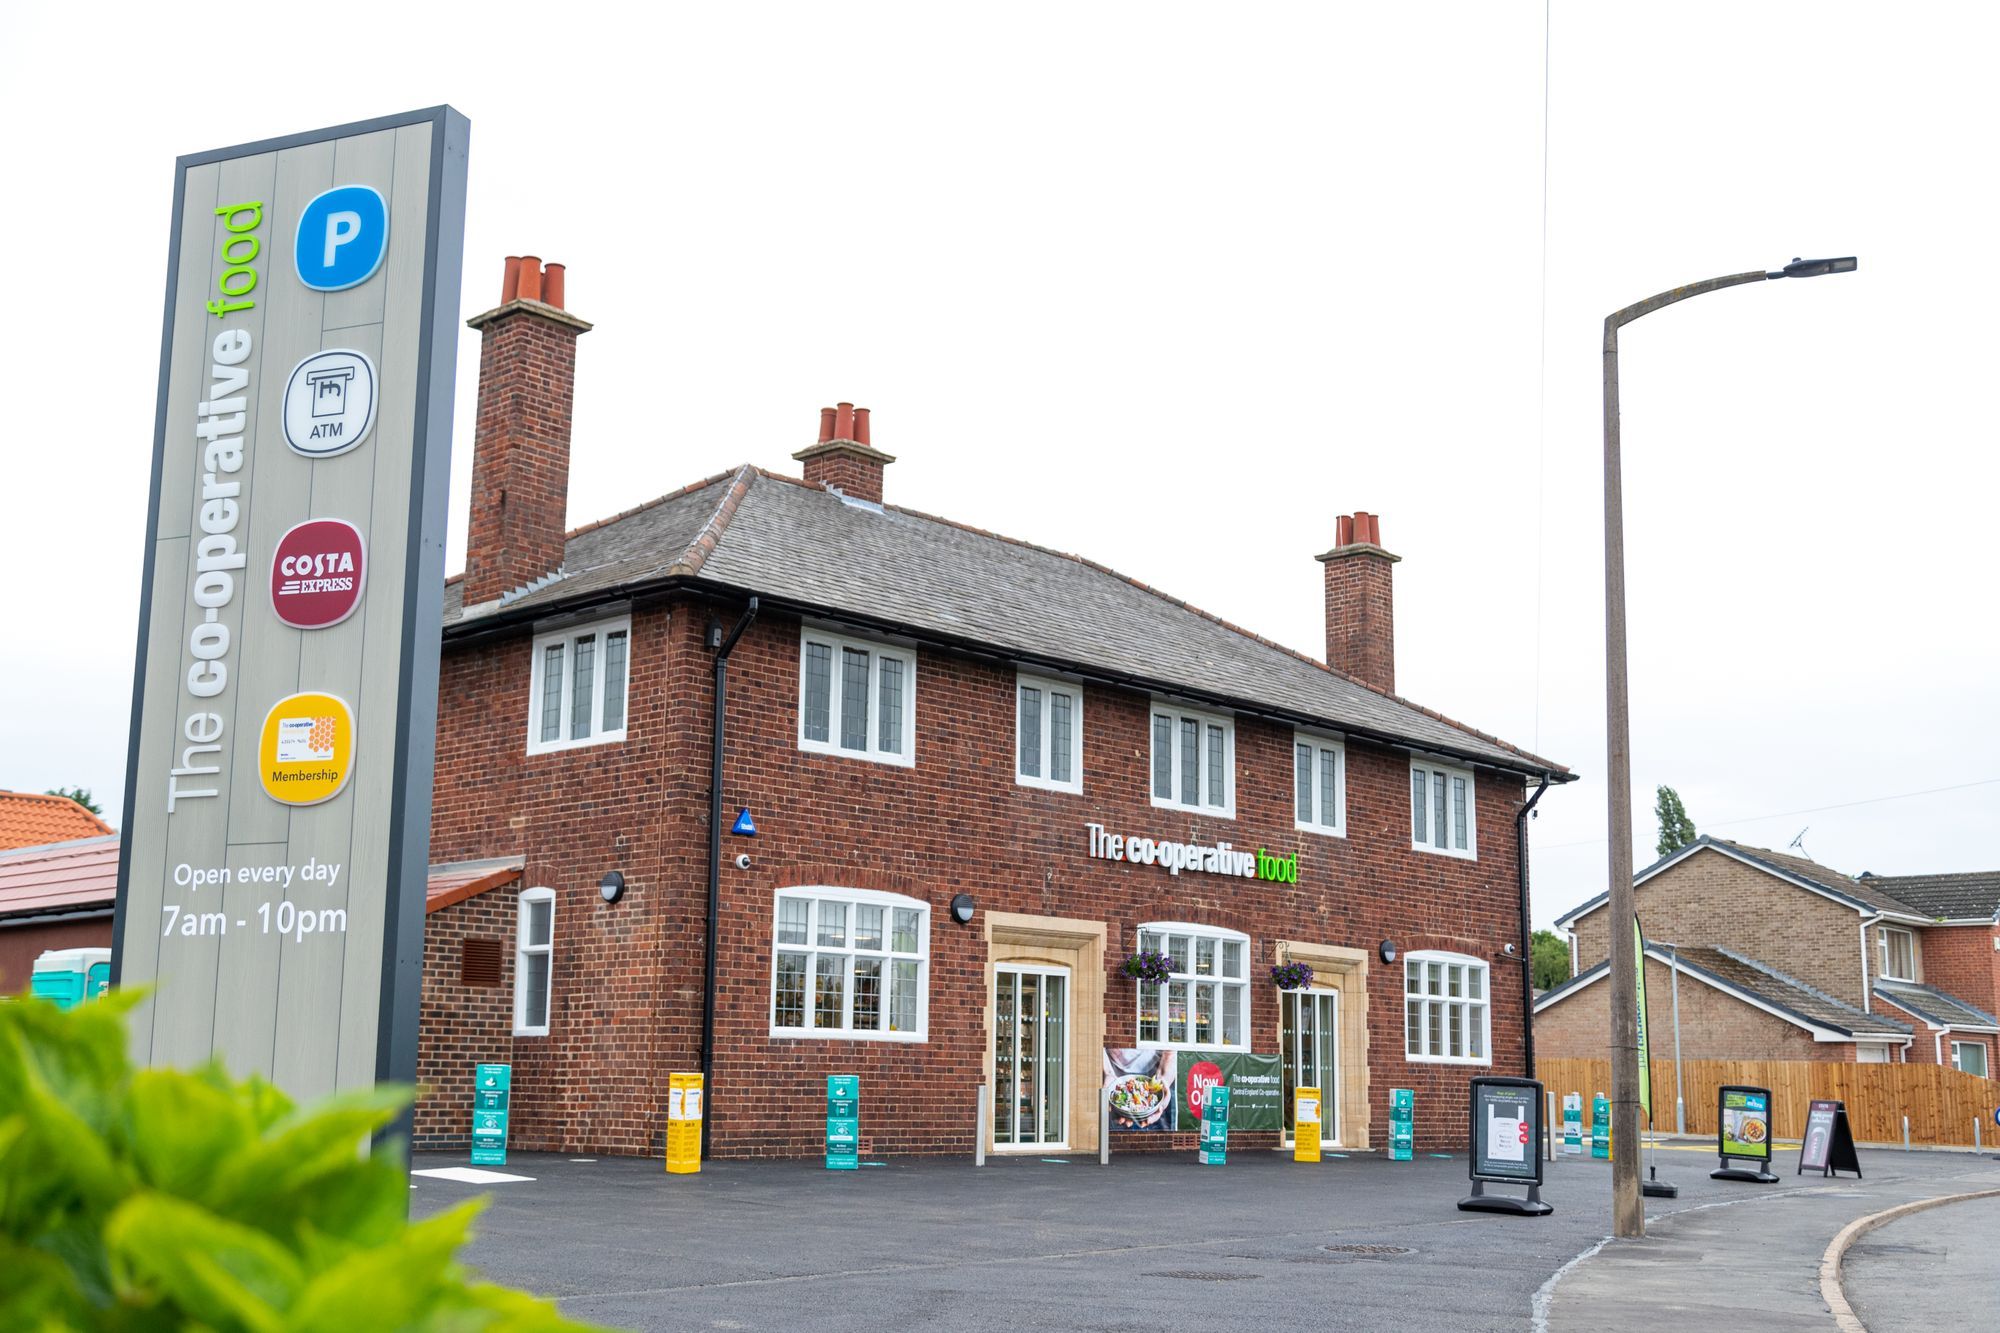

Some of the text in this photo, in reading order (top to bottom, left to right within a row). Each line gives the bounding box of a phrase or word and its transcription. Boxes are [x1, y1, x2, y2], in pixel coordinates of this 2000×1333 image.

[323, 210, 362, 268] P
[309, 422, 343, 439] ATM
[167, 201, 263, 814] The co-operative food
[280, 552, 354, 577] COSTA
[300, 577, 353, 594] EXPRESS
[272, 769, 338, 783] Membership
[1085, 822, 1297, 884] The co-operative food
[173, 857, 341, 891] Open every day
[162, 904, 227, 937] 7am
[257, 900, 347, 943] 10pm
[1193, 1074, 1219, 1088] Now
[1232, 1074, 1280, 1085] The co-operative food
[1245, 1088, 1259, 1097] England
